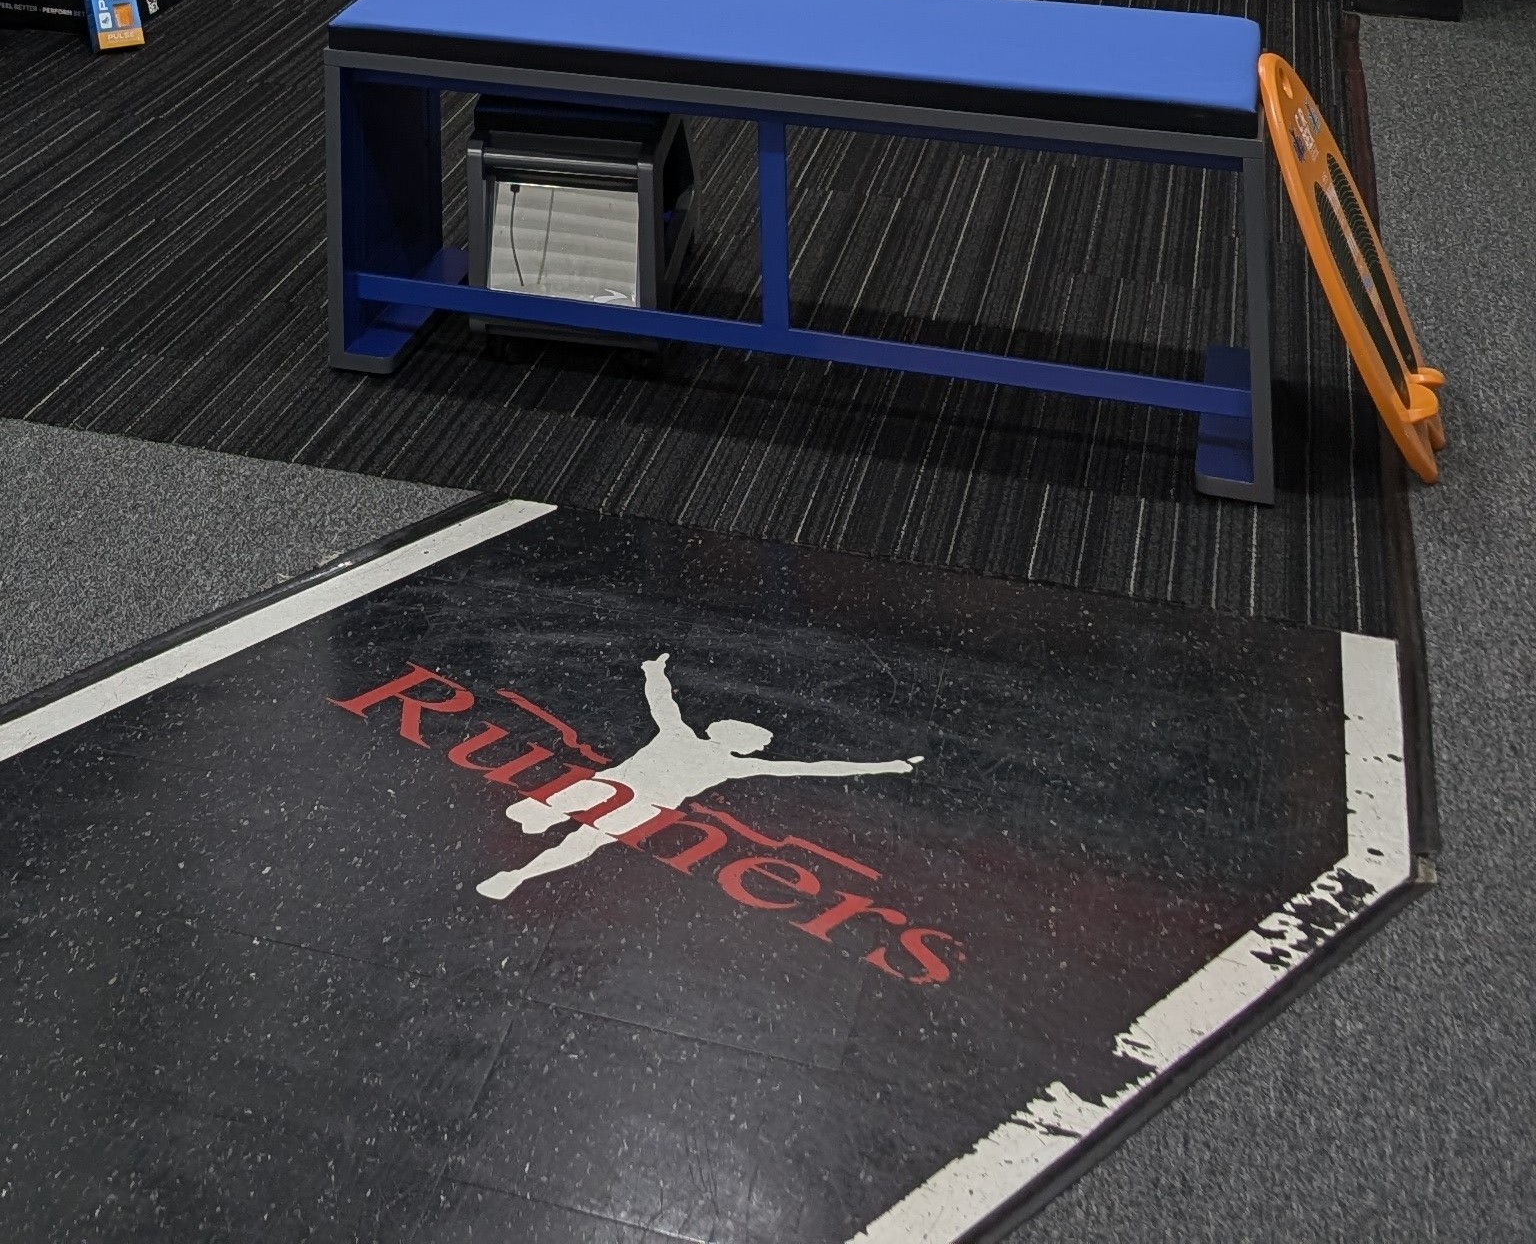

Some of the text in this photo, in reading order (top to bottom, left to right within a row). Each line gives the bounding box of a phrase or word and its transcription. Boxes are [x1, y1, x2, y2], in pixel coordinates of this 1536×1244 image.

[42, 6, 73, 16] PERFORM
[74, 9, 86, 17] BET
[326, 662, 966, 986] Runners
